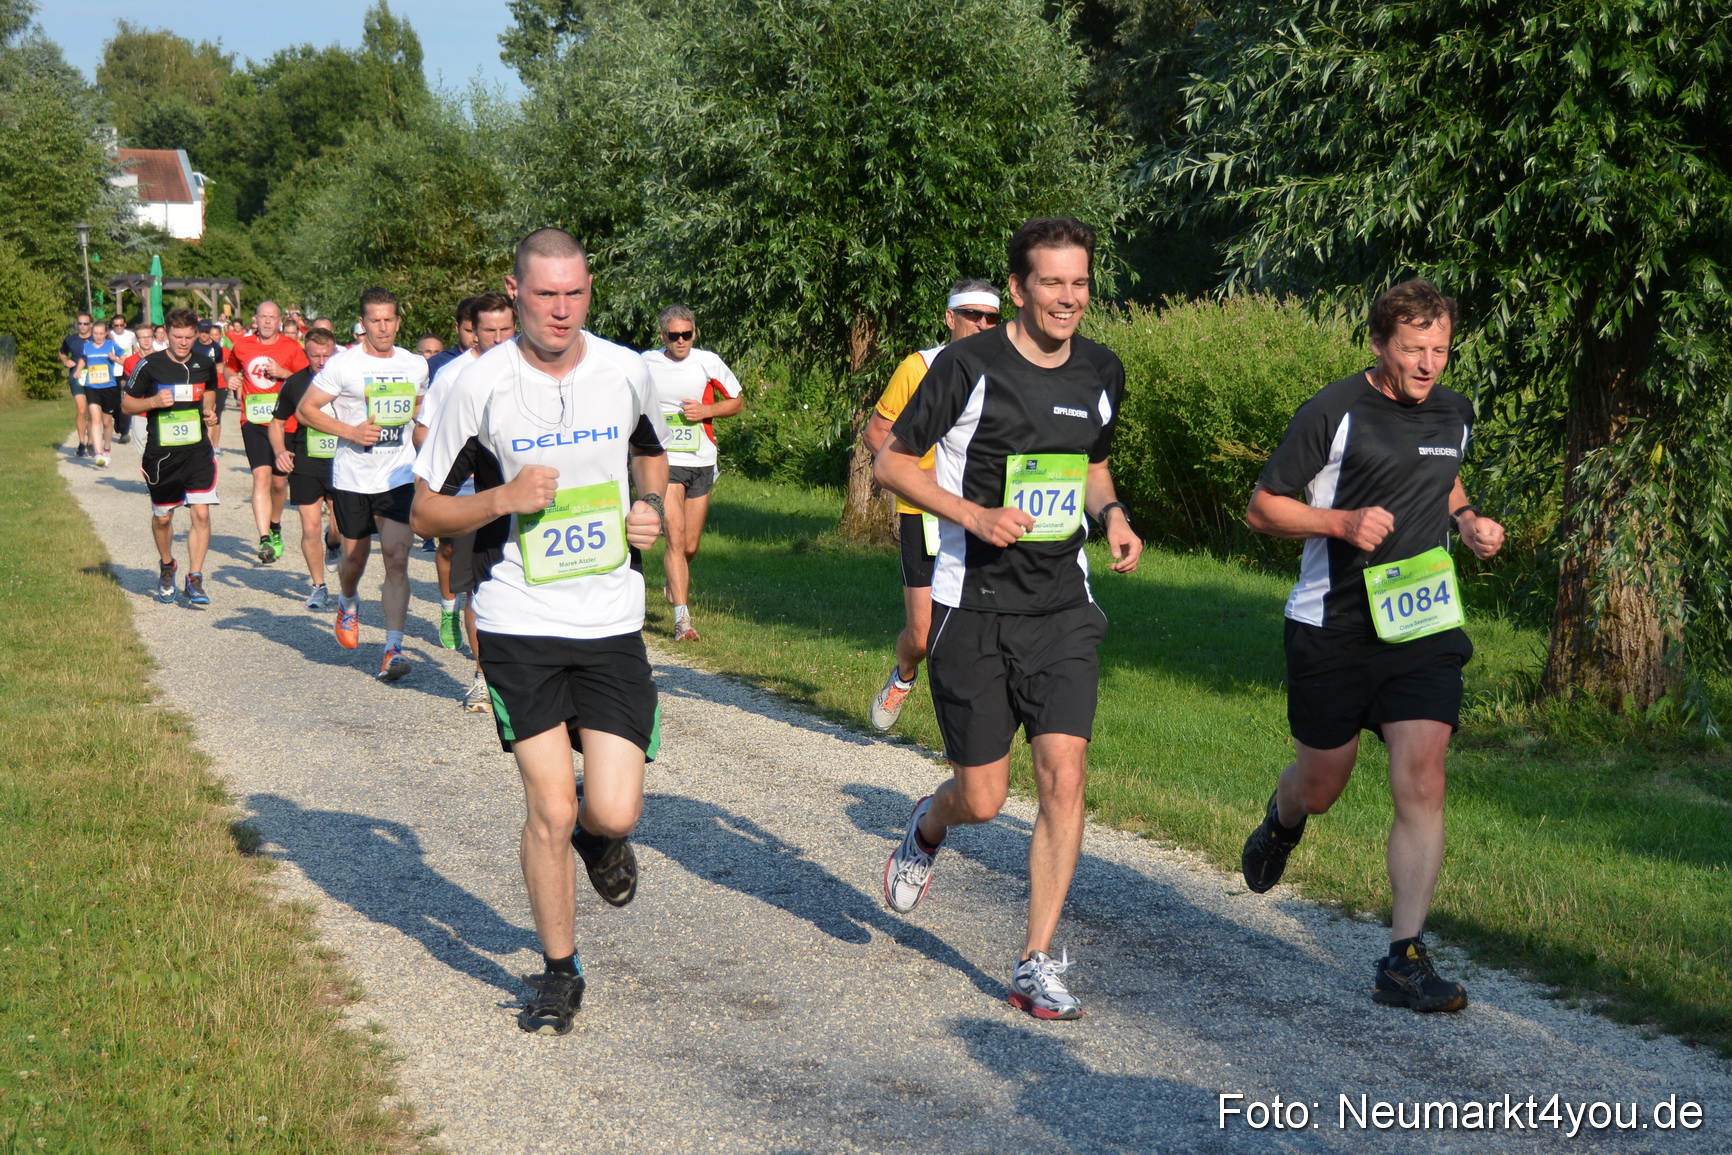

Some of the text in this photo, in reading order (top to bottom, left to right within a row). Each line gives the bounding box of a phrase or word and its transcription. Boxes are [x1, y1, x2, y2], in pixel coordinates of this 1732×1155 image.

[252, 405, 273, 416] 546
[375, 399, 411, 414] 1158
[172, 424, 189, 436] 39
[319, 438, 335, 450] 38
[511, 426, 619, 452] DELPHI
[1013, 489, 1076, 517] 1074
[542, 521, 606, 558] 265
[558, 556, 597, 568] Marek Atzler
[1380, 580, 1451, 623] 1084
[1399, 622, 1414, 631] Claus
[1413, 615, 1439, 627] Seemann
